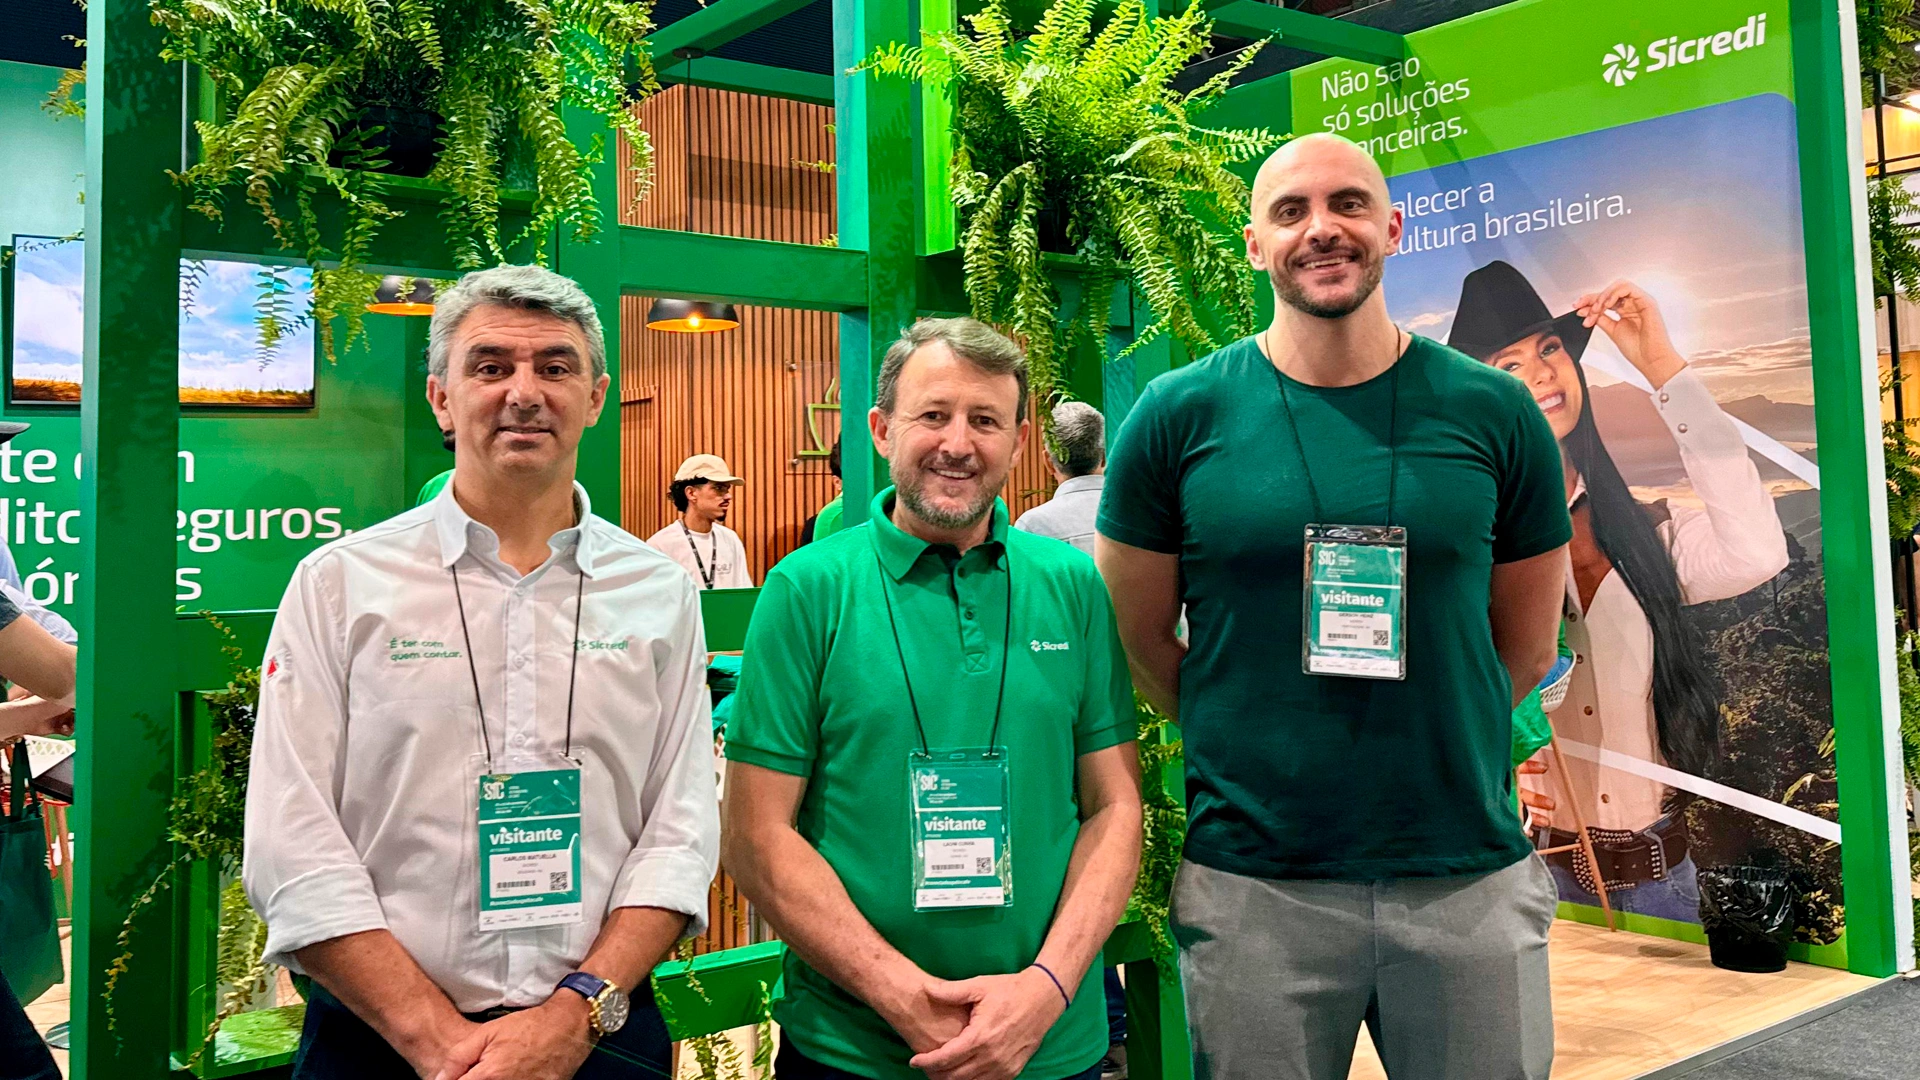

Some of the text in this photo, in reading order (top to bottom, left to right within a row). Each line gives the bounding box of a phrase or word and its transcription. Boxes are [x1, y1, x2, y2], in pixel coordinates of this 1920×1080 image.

[1646, 12, 1767, 73] Sicredi
[1322, 69, 1369, 102] Não
[1322, 77, 1470, 134] só soluções
[1478, 182, 1495, 204] a
[1391, 193, 1632, 257] ultura brasileira.
[1318, 550, 1336, 566] SIC
[1320, 590, 1384, 607] visitante
[390, 637, 397, 649] É
[401, 640, 418, 648] ter
[588, 640, 629, 650] Sicredi
[390, 650, 462, 662] quem contar.
[924, 817, 986, 831] visitante
[489, 827, 562, 845] visitante
